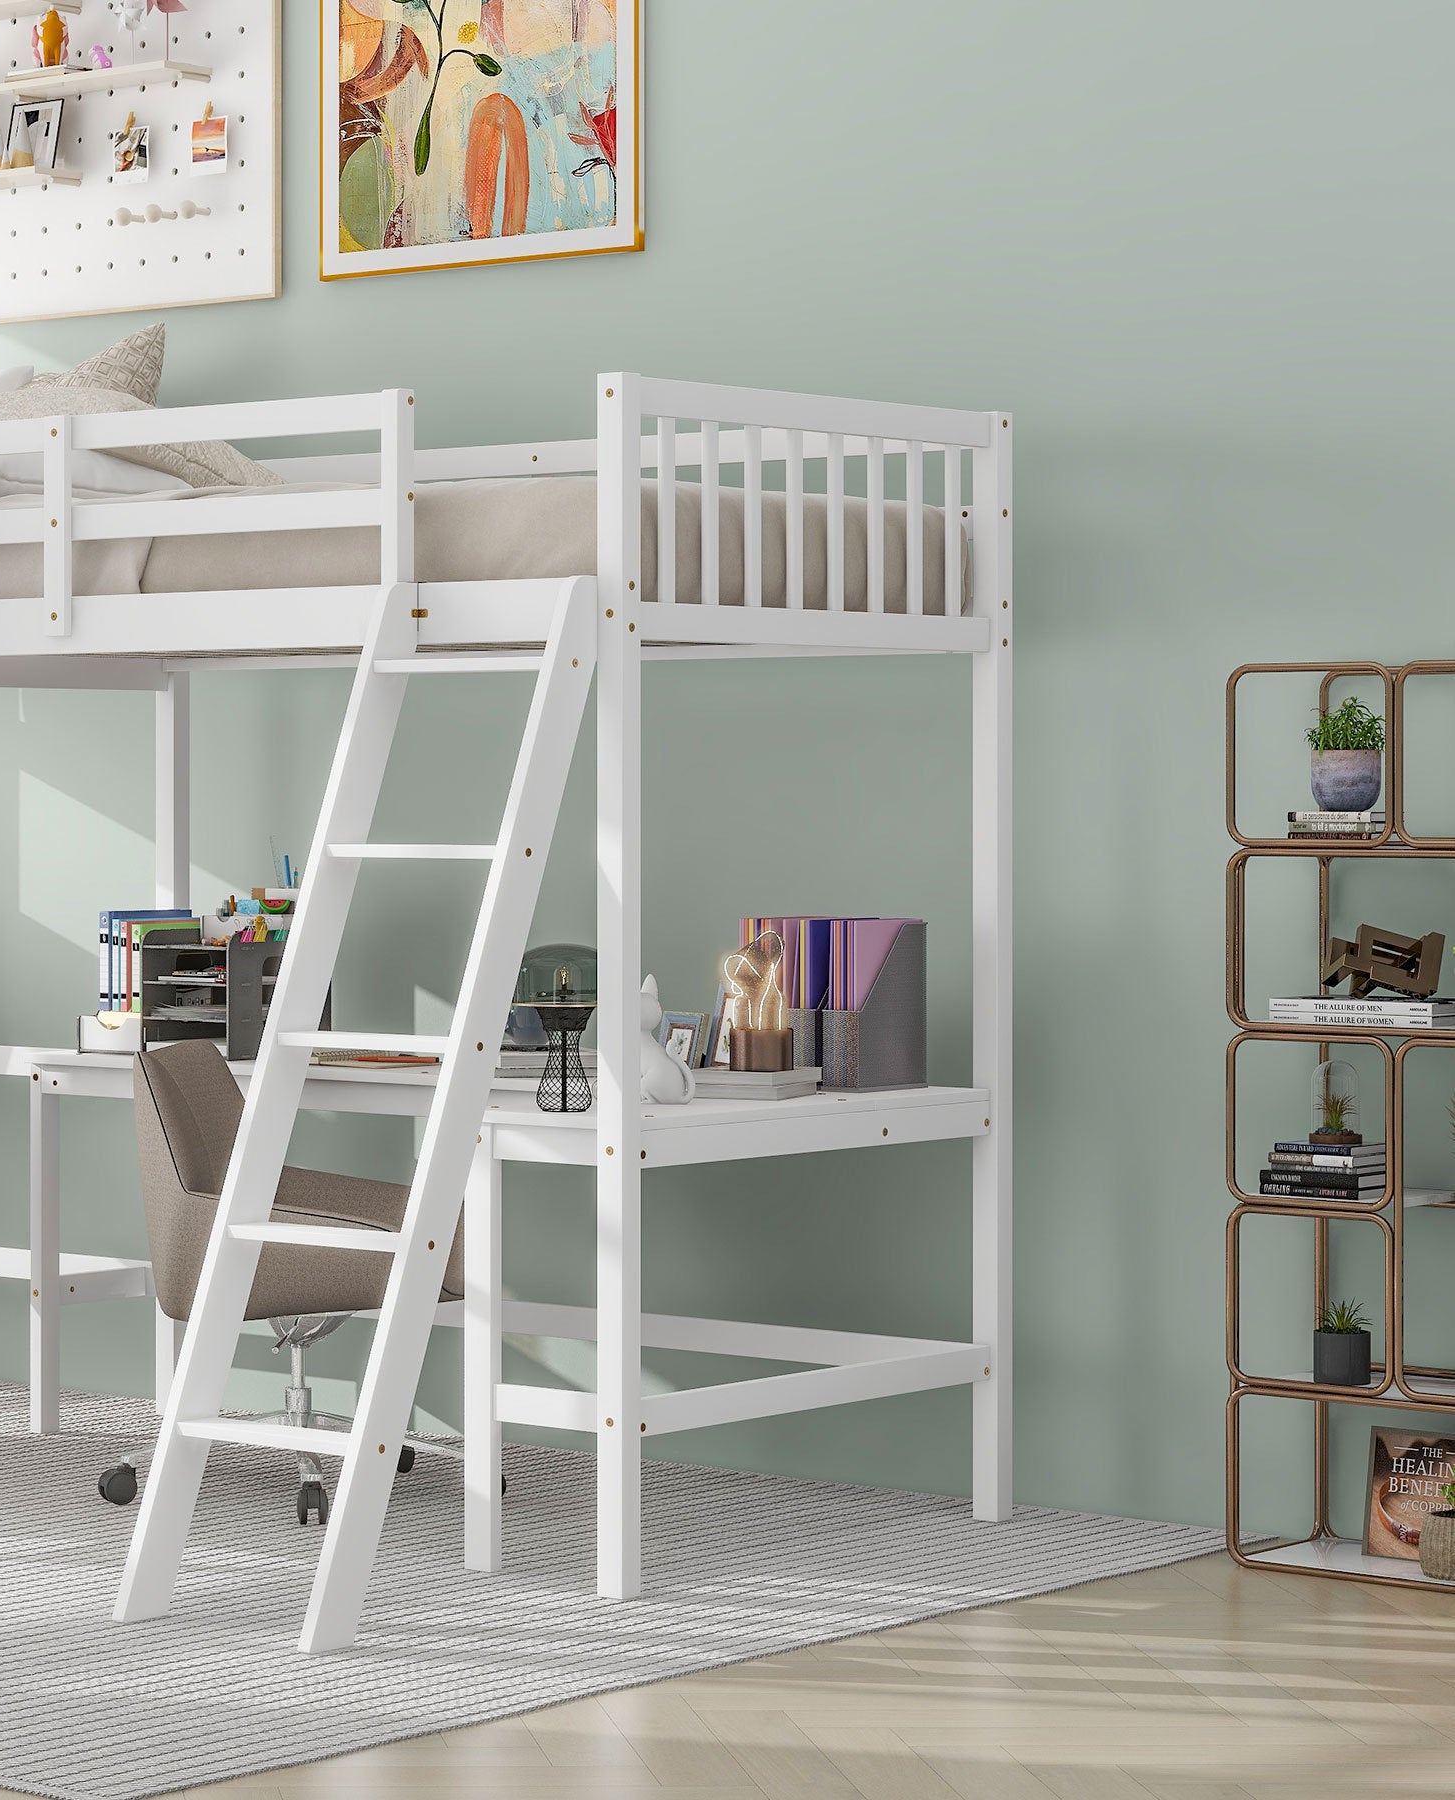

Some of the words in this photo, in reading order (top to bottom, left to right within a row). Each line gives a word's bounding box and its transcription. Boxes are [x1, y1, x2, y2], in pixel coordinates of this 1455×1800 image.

[1329, 1003, 1355, 1011] ALLURE
[1329, 1016, 1355, 1024] ALLURE
[1367, 1017, 1394, 1025] WOMEN
[1422, 1447, 1443, 1458] THE
[1401, 1500, 1412, 1513] of
